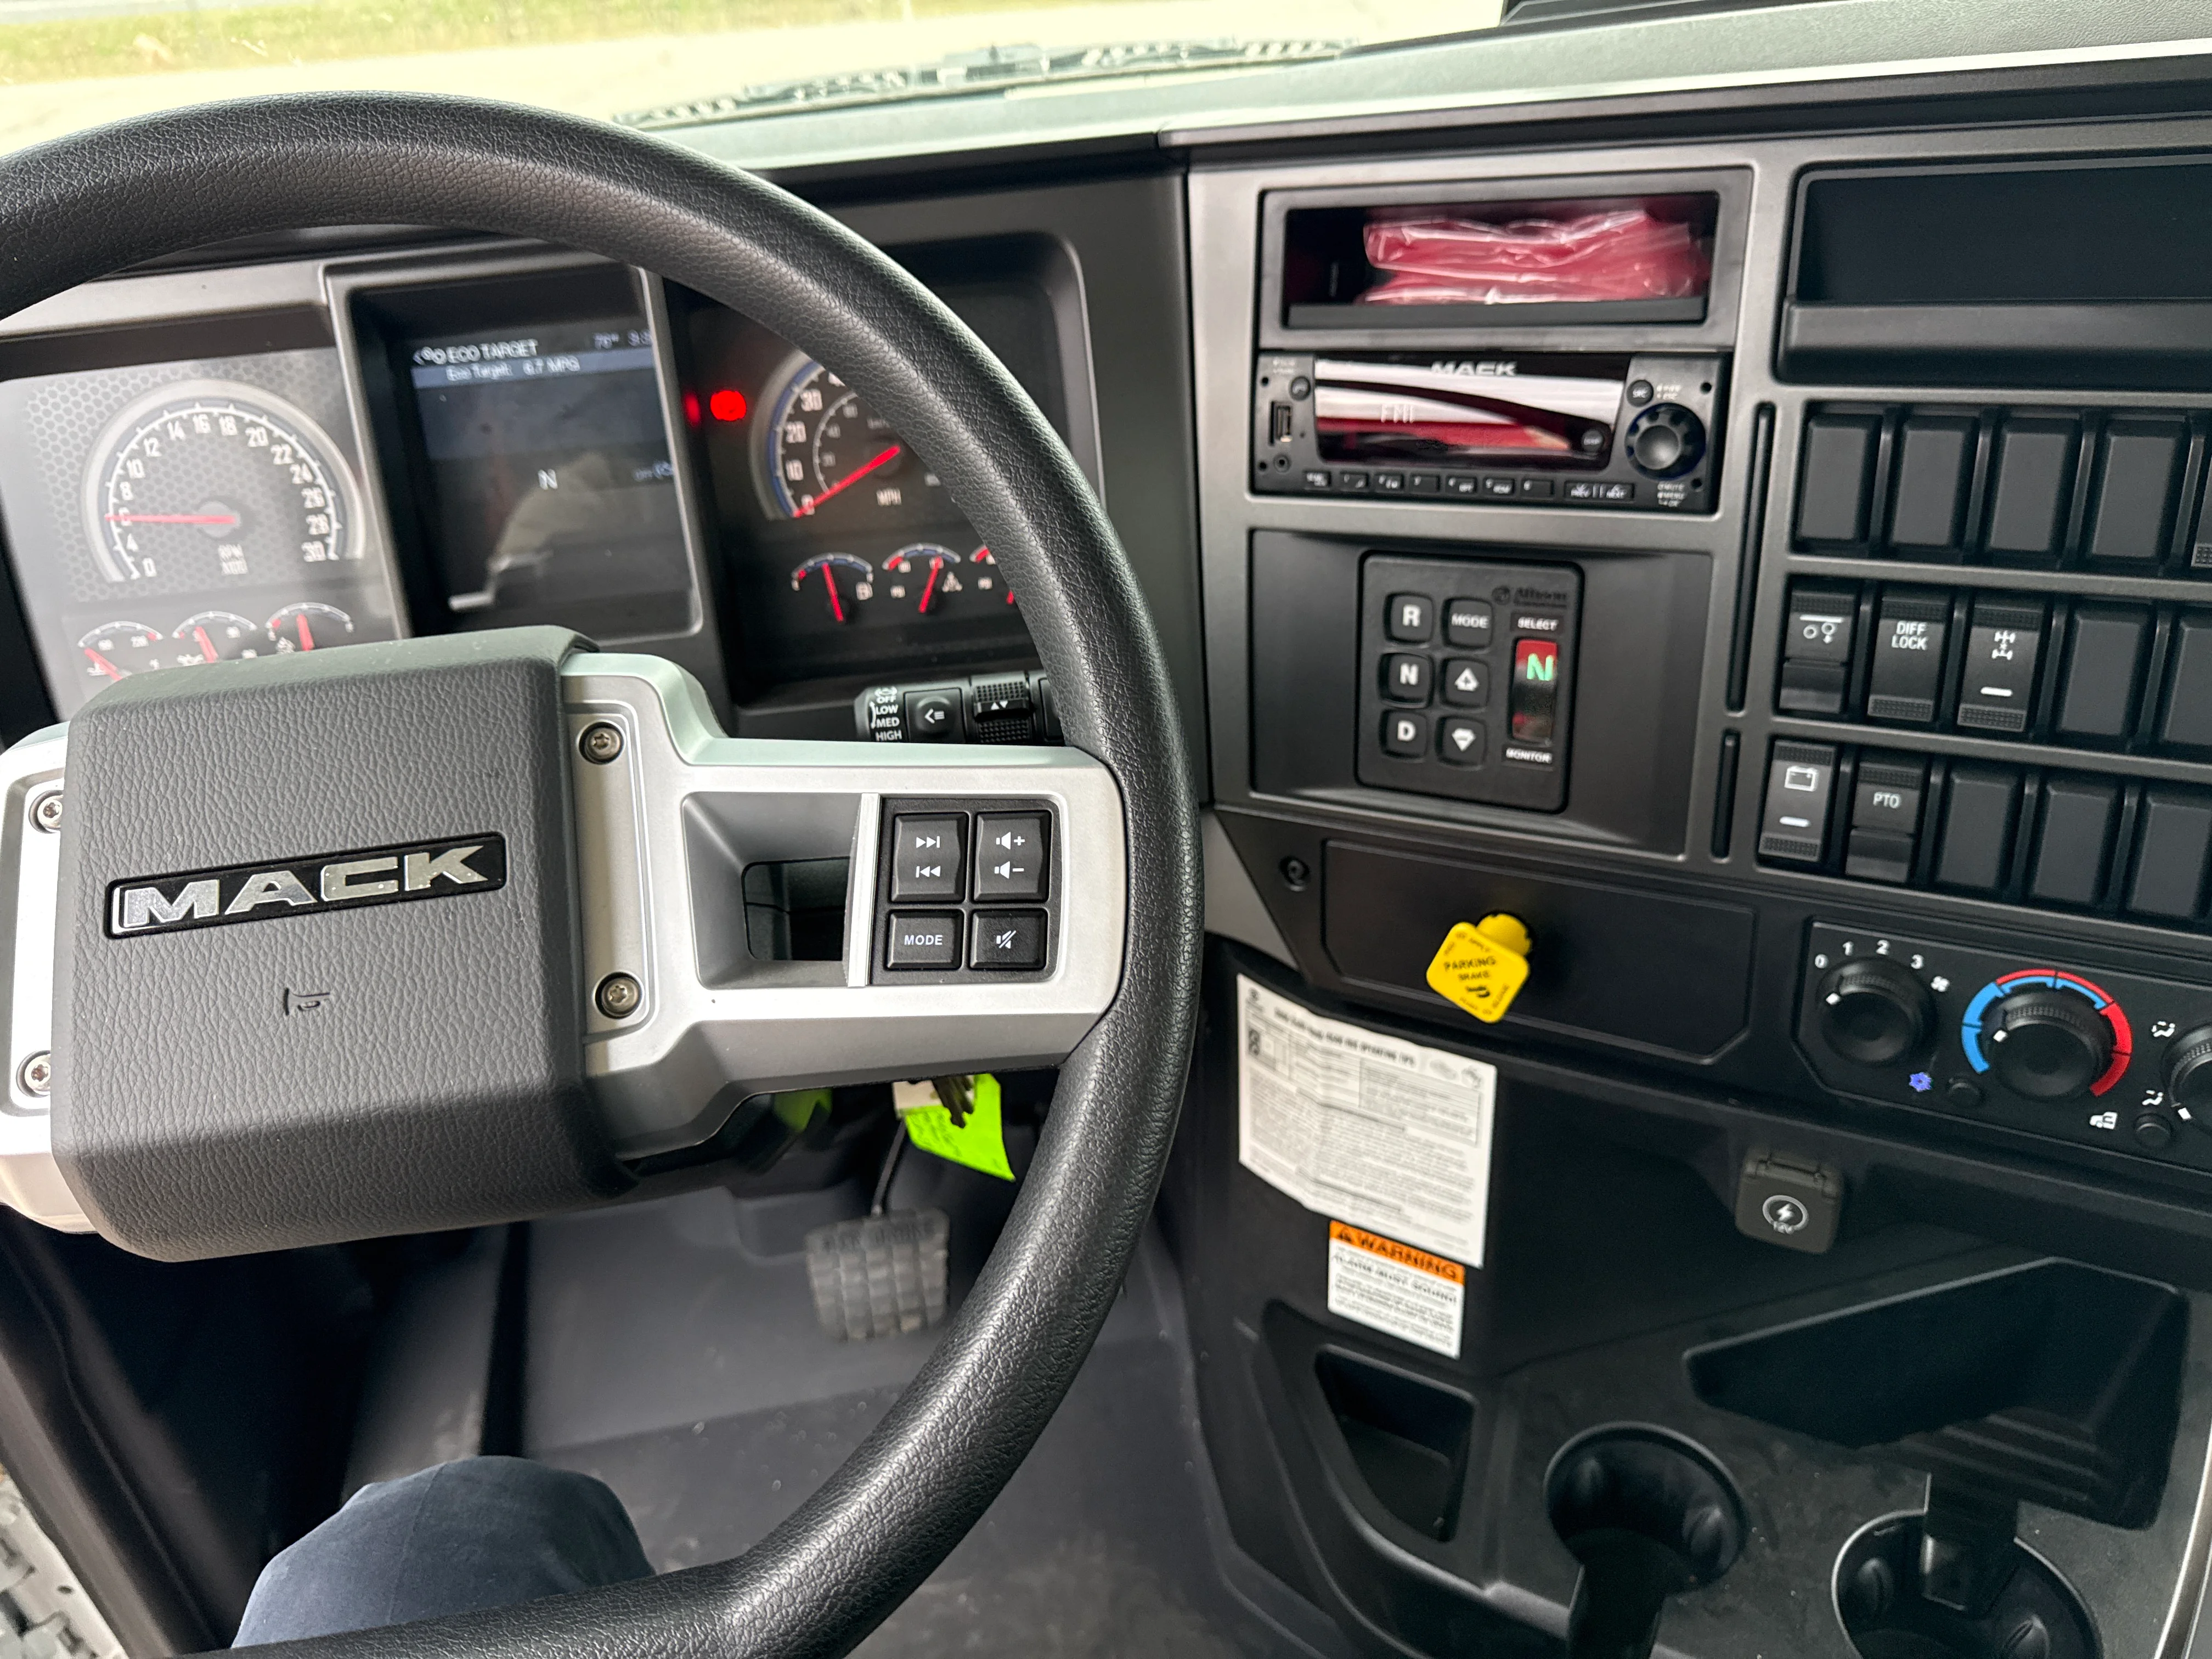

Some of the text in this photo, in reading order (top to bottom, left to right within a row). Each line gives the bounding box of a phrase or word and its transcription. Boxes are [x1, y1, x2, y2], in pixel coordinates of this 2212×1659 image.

[479, 338, 539, 360] TARGET
[1431, 361, 1517, 376] MACK
[167, 421, 187, 441] 14
[245, 427, 269, 447] 20
[144, 437, 162, 457] 12
[270, 444, 295, 465] 22
[126, 459, 145, 478] 10
[290, 464, 313, 484] 24
[538, 469, 558, 490] N
[120, 482, 133, 500] 8
[126, 533, 138, 552] 4
[301, 540, 326, 562] 30
[142, 557, 157, 577] 0
[1402, 604, 1422, 628] R
[1452, 613, 1489, 629] MODE
[1518, 616, 1559, 631] SELECT
[1896, 620, 1927, 636] DIFF
[1892, 635, 1928, 651] LOCK
[1400, 663, 1419, 686] N
[1526, 653, 1554, 681] N
[876, 695, 896, 704] OFF
[876, 704, 898, 716] LOW
[876, 716, 900, 729] MED
[1397, 720, 1416, 742] D
[875, 730, 902, 742] HIGH
[1505, 748, 1553, 764] MONITOR
[1873, 791, 1901, 809] PTO
[123, 845, 489, 928] MACK
[904, 934, 943, 945] MODE
[1843, 940, 1854, 956] 1
[1876, 940, 1890, 956] 2
[1443, 956, 1497, 971] PARKING
[1815, 953, 1829, 969] 0
[1910, 953, 1924, 969] 3
[1358, 1232, 1458, 1280] WARNING
